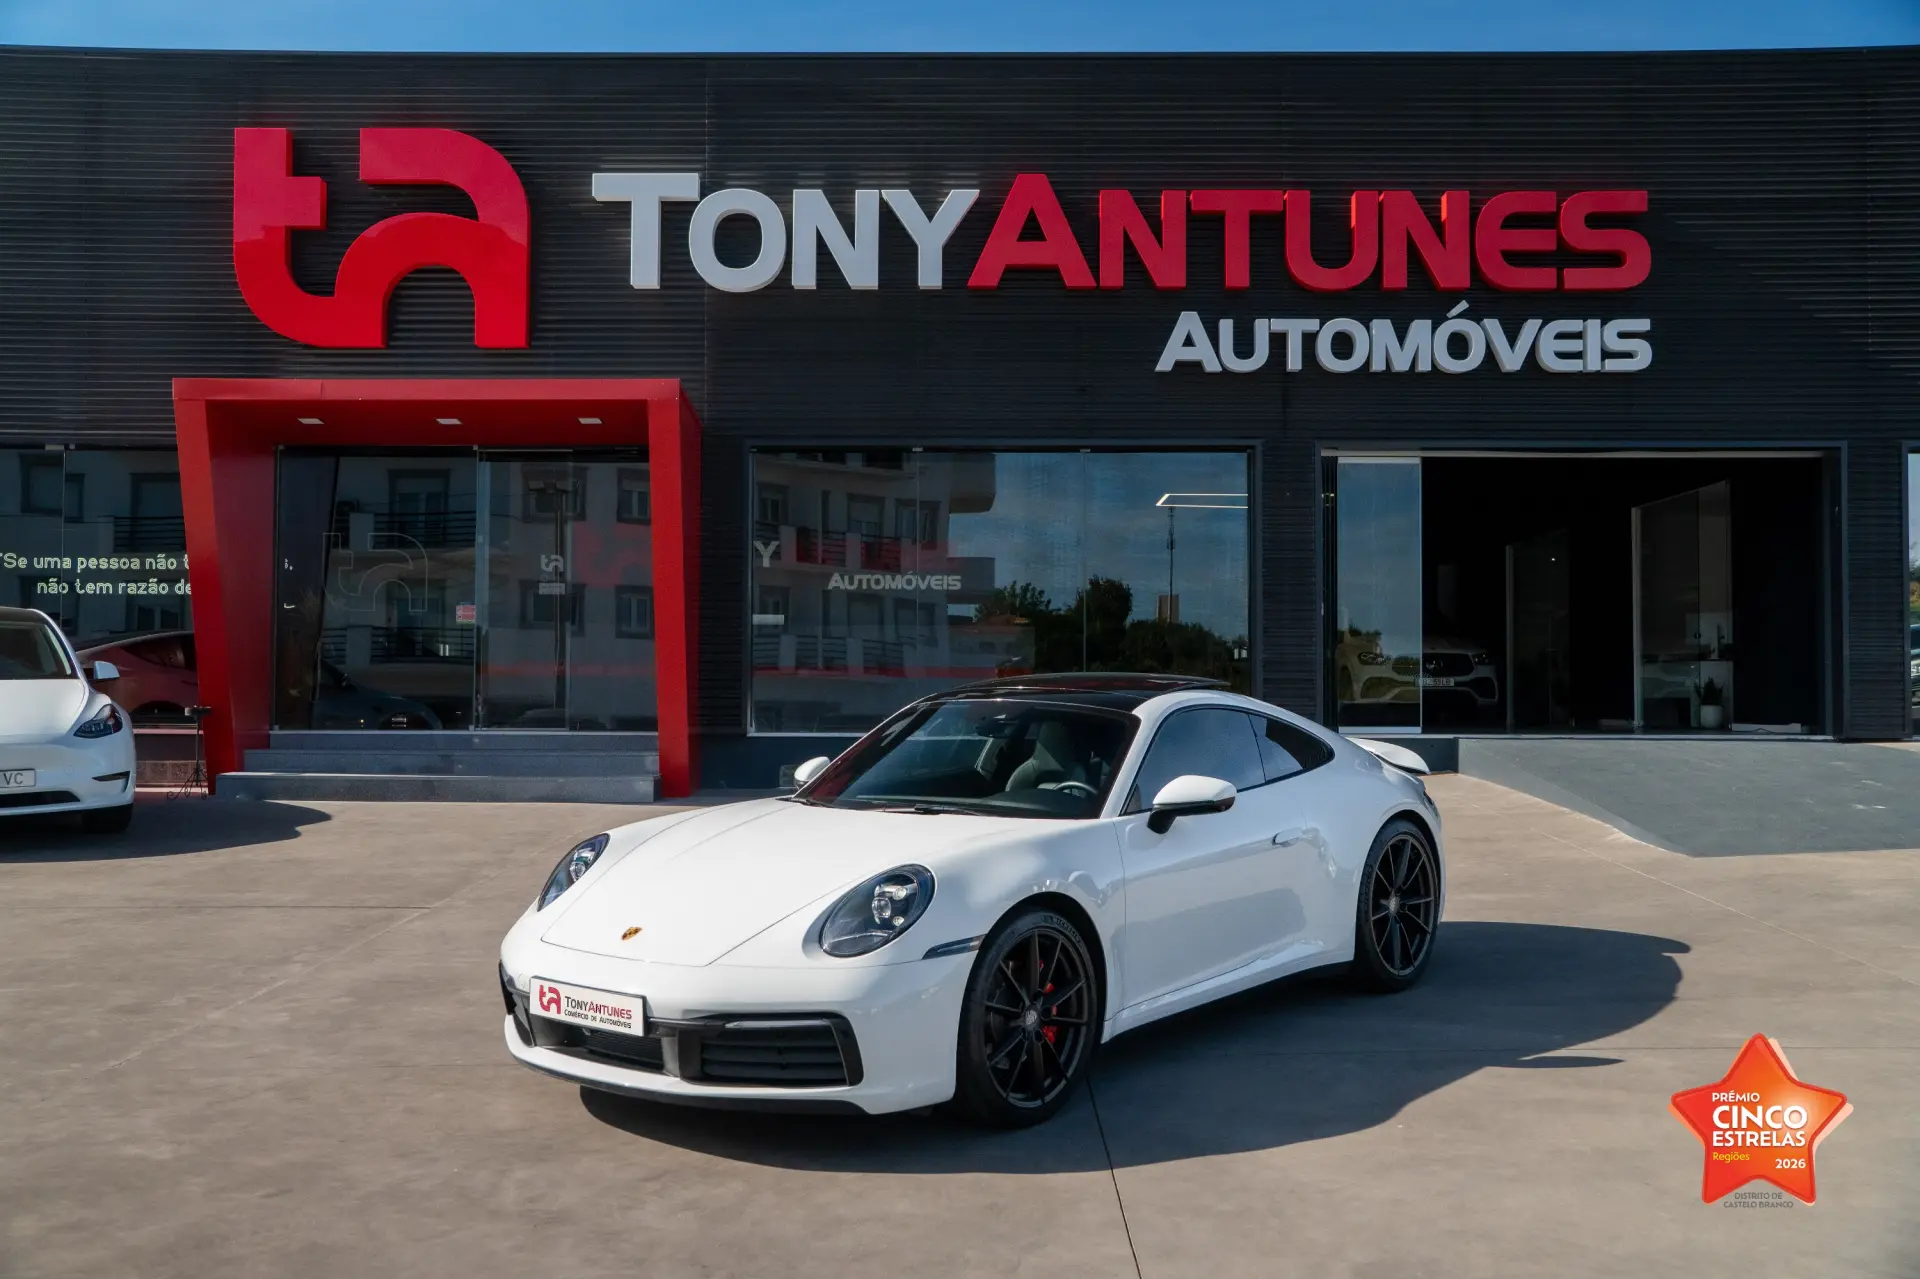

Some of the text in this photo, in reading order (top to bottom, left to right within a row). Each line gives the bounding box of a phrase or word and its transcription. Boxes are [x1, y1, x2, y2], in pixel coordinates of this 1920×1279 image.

[1154, 300, 1652, 374] AUTOMÓVEIS
[33, 557, 72, 569] uma
[77, 557, 141, 573] pessoa
[145, 554, 177, 570] não
[37, 578, 69, 595] não
[75, 578, 113, 595] tem
[118, 578, 169, 595] razão
[827, 571, 963, 591] AUTOMÓVEIS
[564, 1009, 632, 1029] COMÉRCIO DE AUTOMÓVEIS
